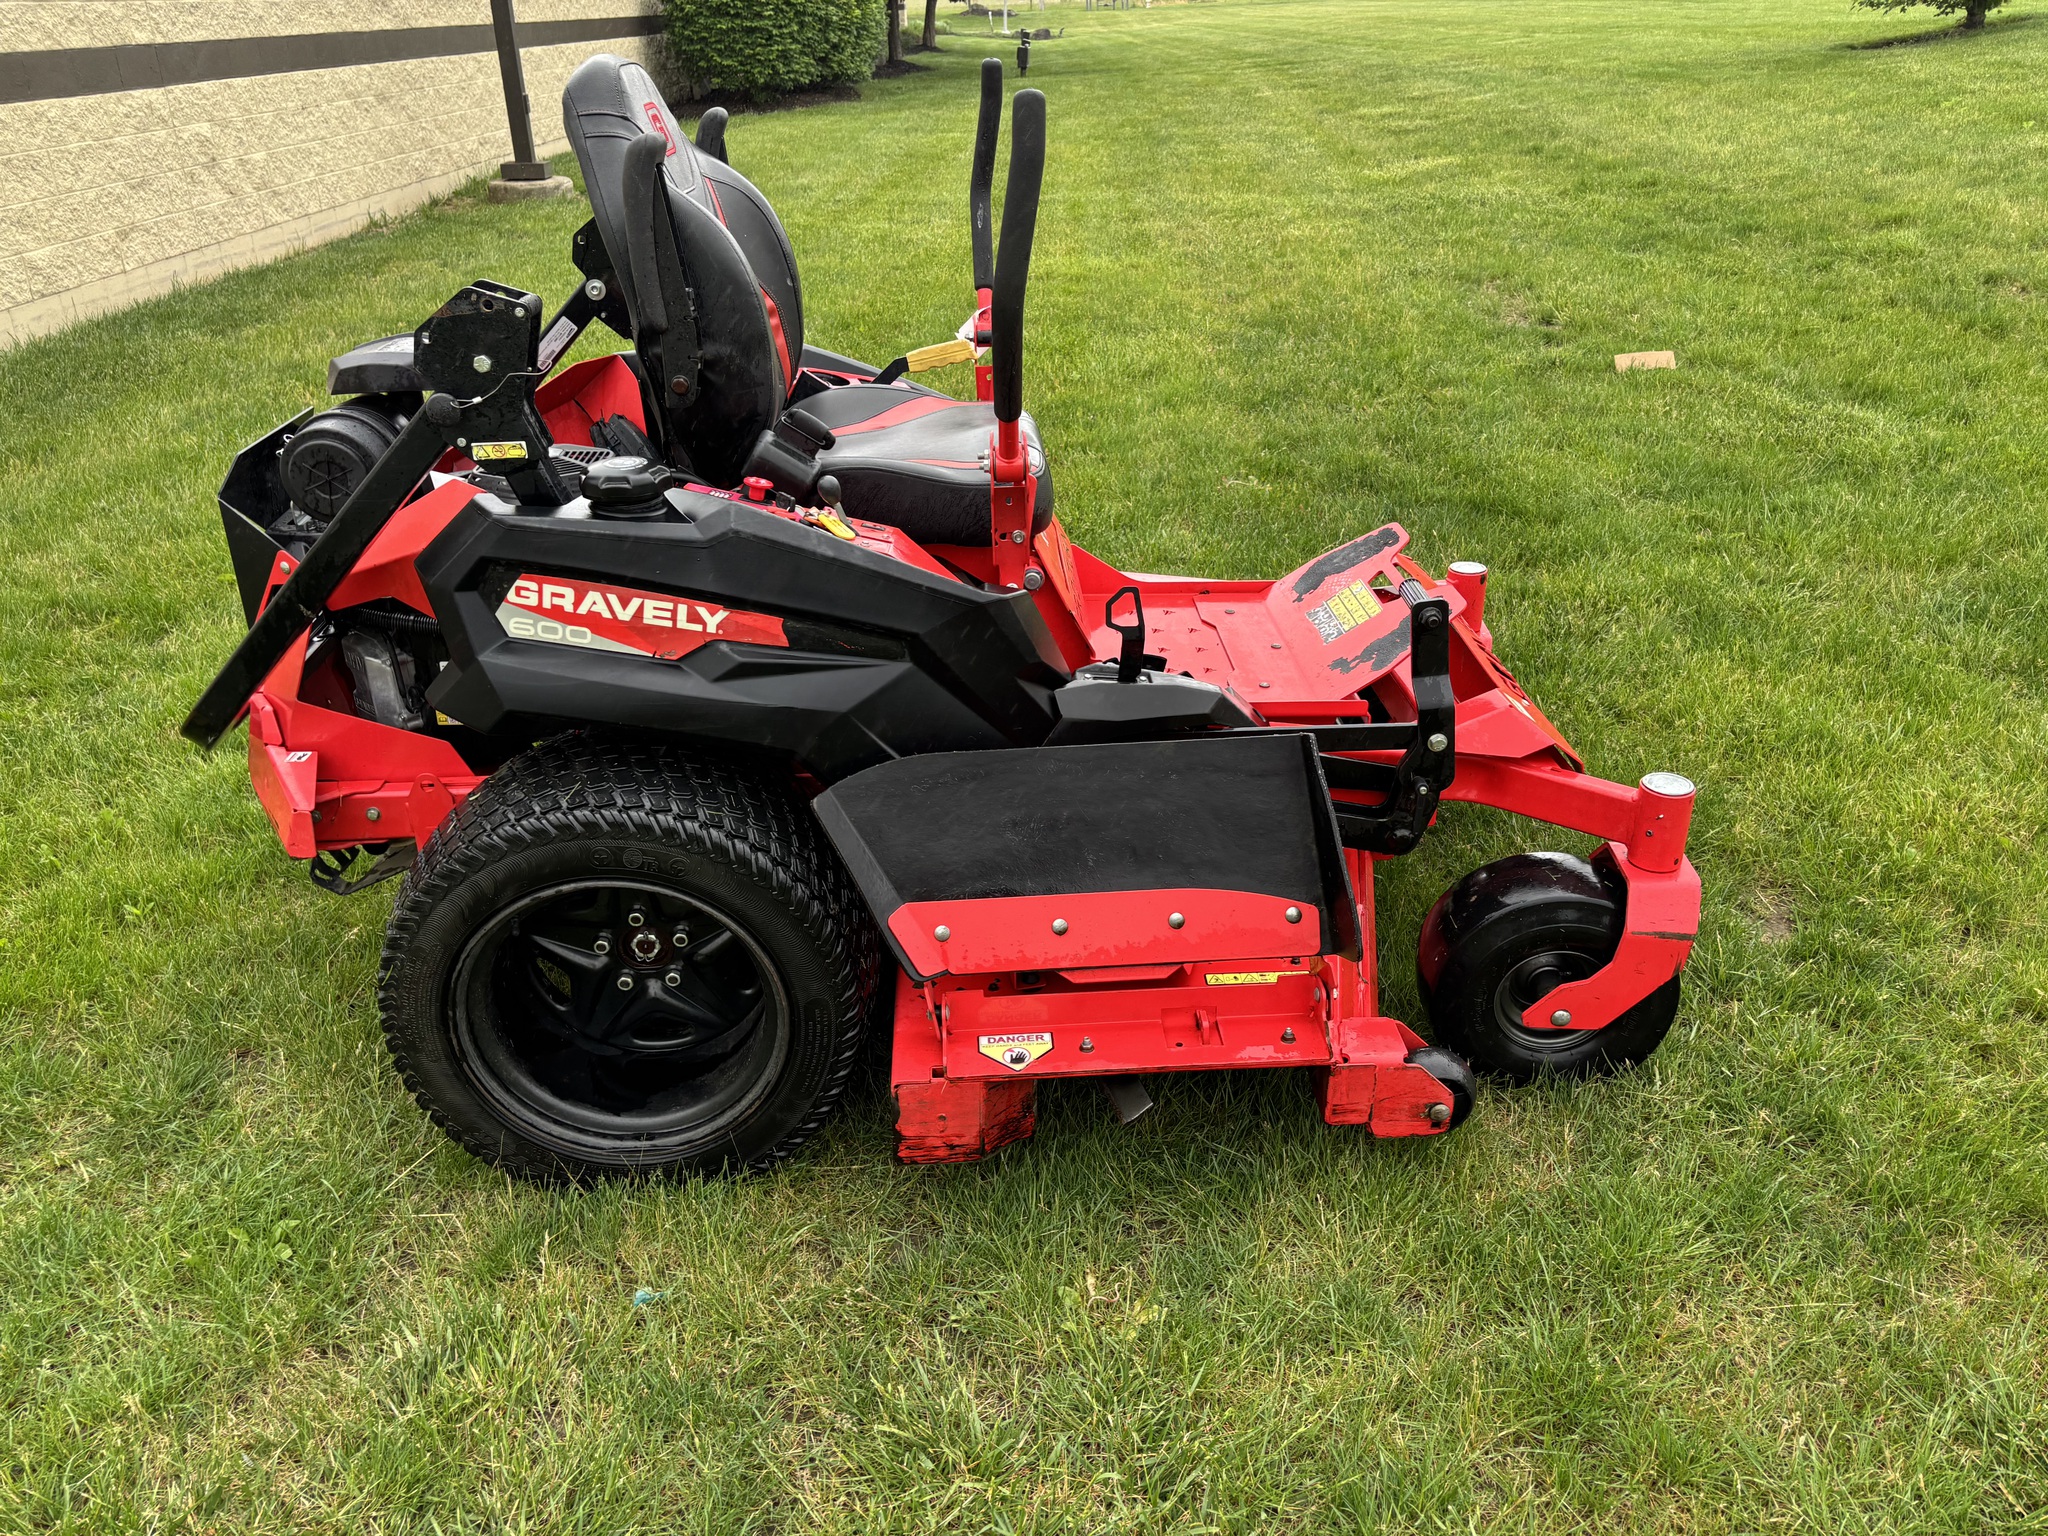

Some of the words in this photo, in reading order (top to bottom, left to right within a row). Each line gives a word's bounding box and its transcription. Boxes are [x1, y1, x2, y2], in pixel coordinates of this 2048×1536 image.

[506, 579, 731, 634] GRAVELY
[508, 617, 592, 644] 600
[987, 1034, 1045, 1044] DANGER
